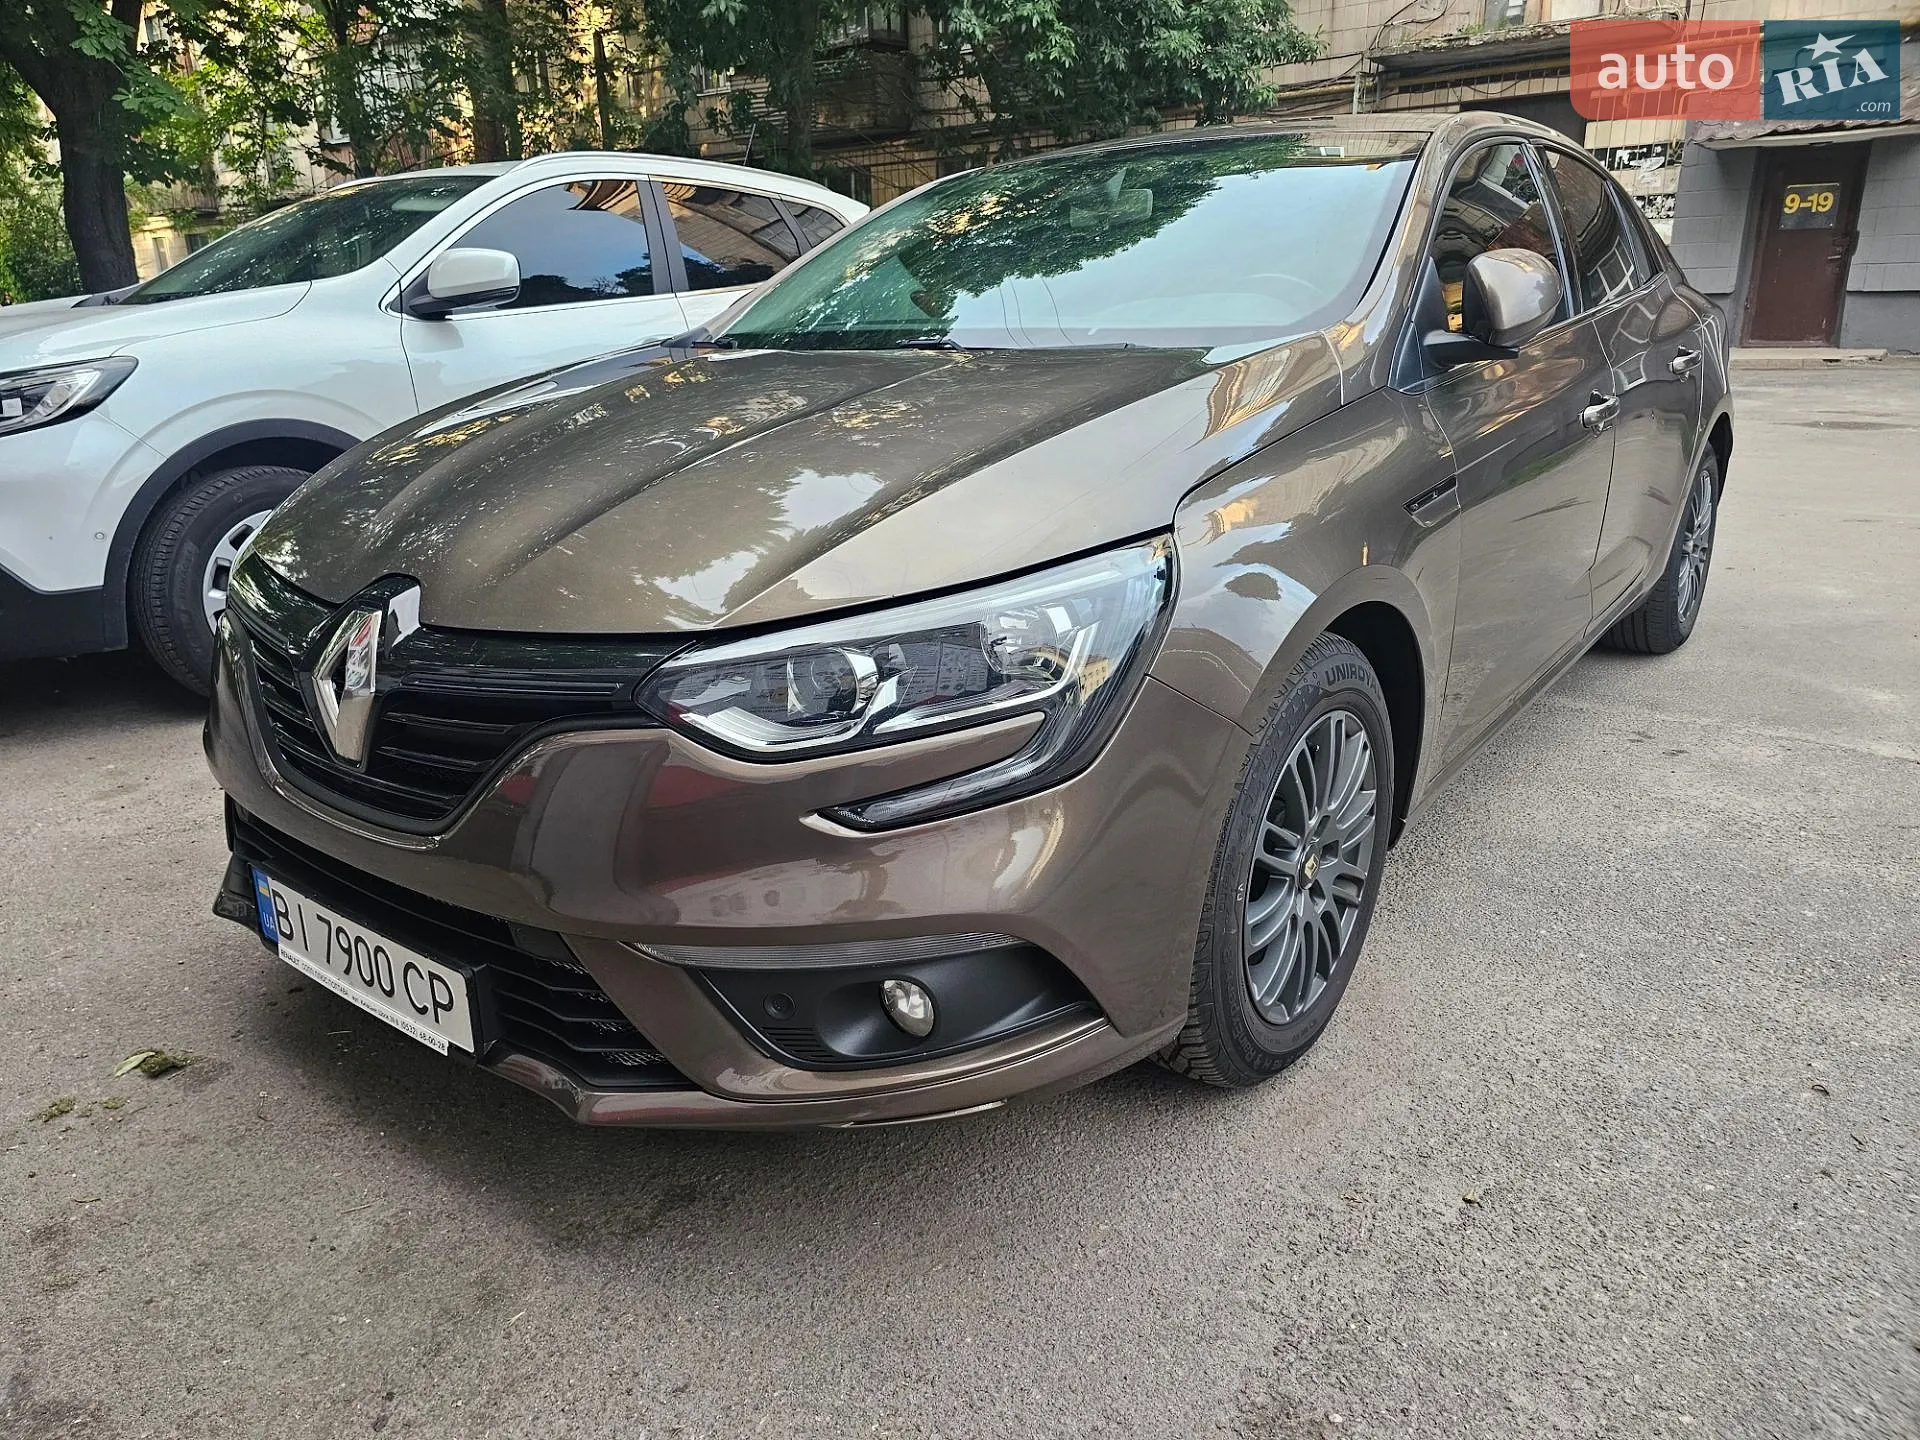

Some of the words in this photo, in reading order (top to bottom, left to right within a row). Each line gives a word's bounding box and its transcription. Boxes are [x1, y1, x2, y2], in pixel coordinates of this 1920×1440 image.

[1783, 192, 1834, 214] 9-19
[263, 912, 276, 931] UA
[271, 888, 309, 952] BI
[316, 913, 395, 998] 7900
[403, 961, 454, 1025] CP
